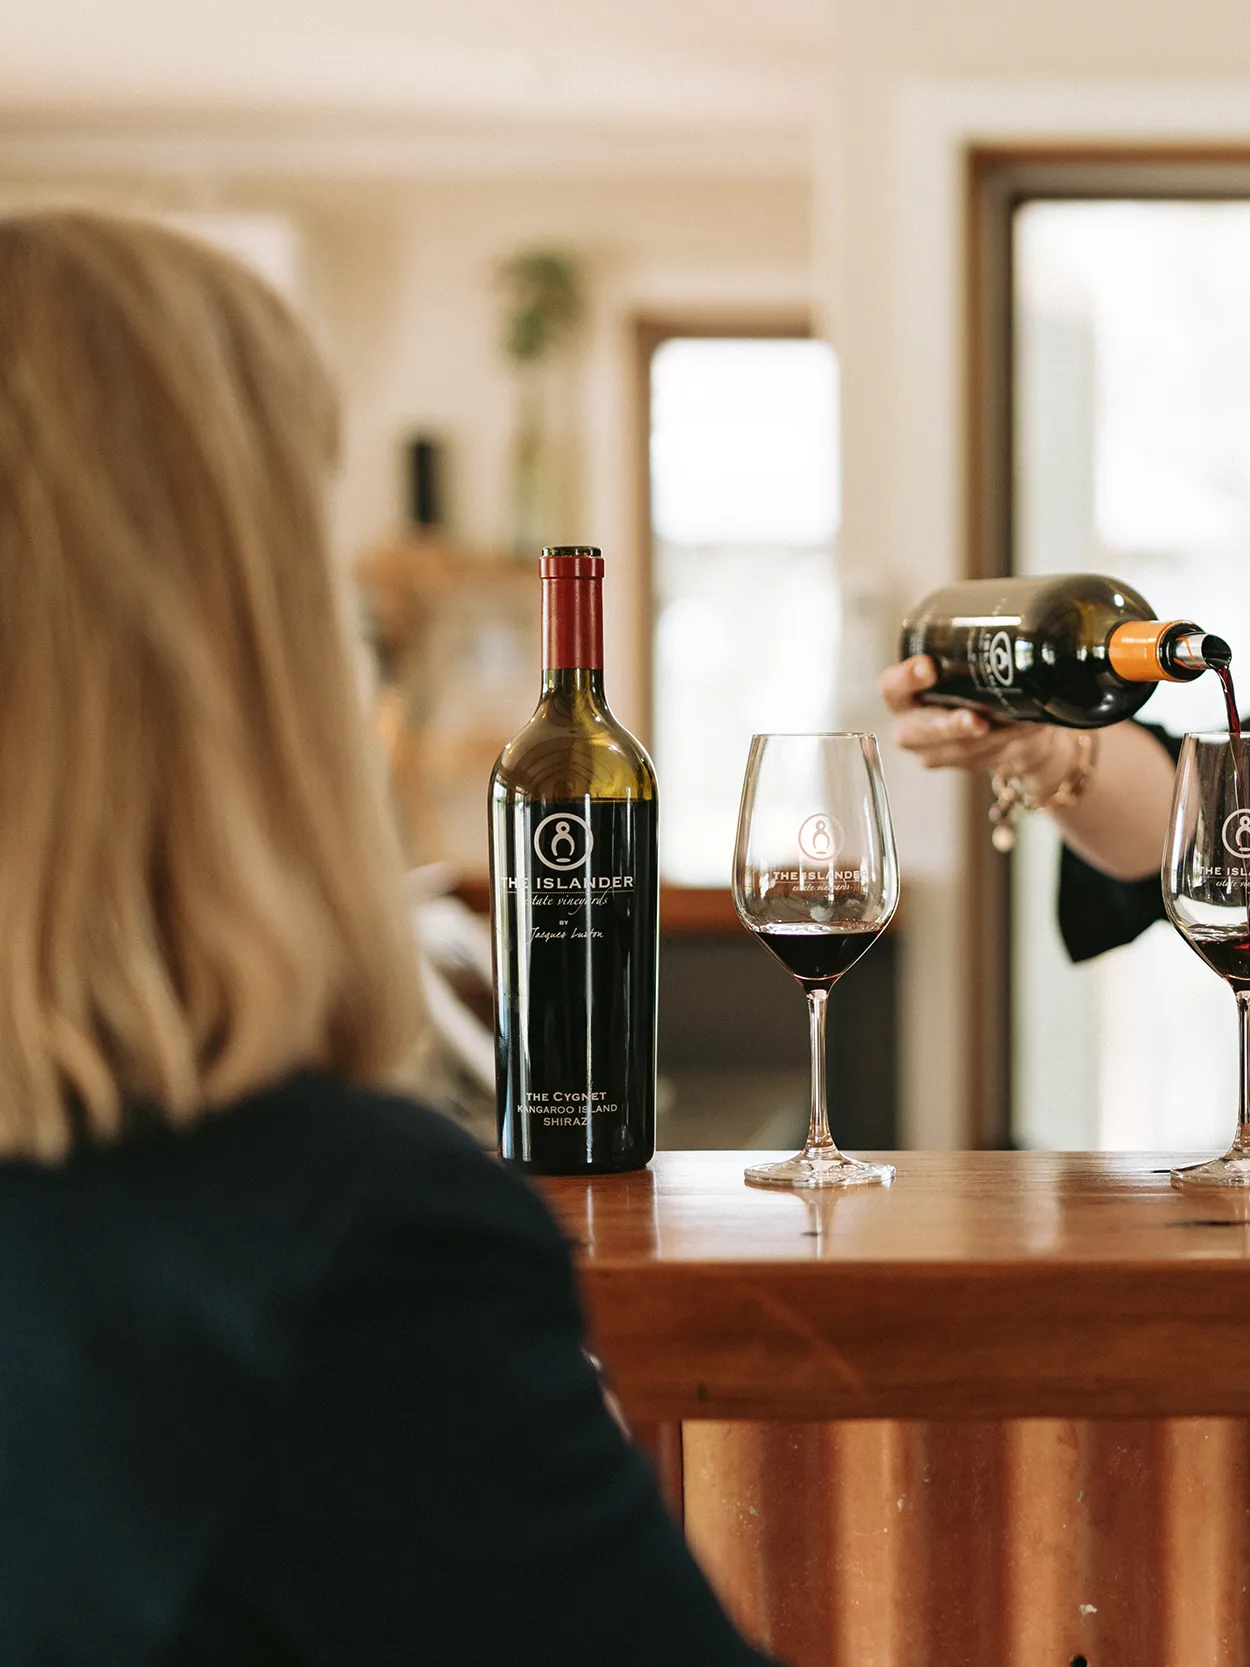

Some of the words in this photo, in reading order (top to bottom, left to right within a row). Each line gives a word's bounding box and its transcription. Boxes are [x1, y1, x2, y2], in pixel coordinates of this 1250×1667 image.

[773, 871, 798, 880] THE
[803, 870, 867, 880] ISLANDER
[1200, 867, 1222, 876] THE
[501, 876, 532, 889] THE
[537, 876, 634, 889] ISLANDER
[557, 887, 608, 916] vineyrds
[526, 1092, 549, 1101] THE
[553, 1092, 607, 1102] CYGNET
[517, 1104, 574, 1114] KANGAROO
[543, 1117, 588, 1126] SHIRAZ
